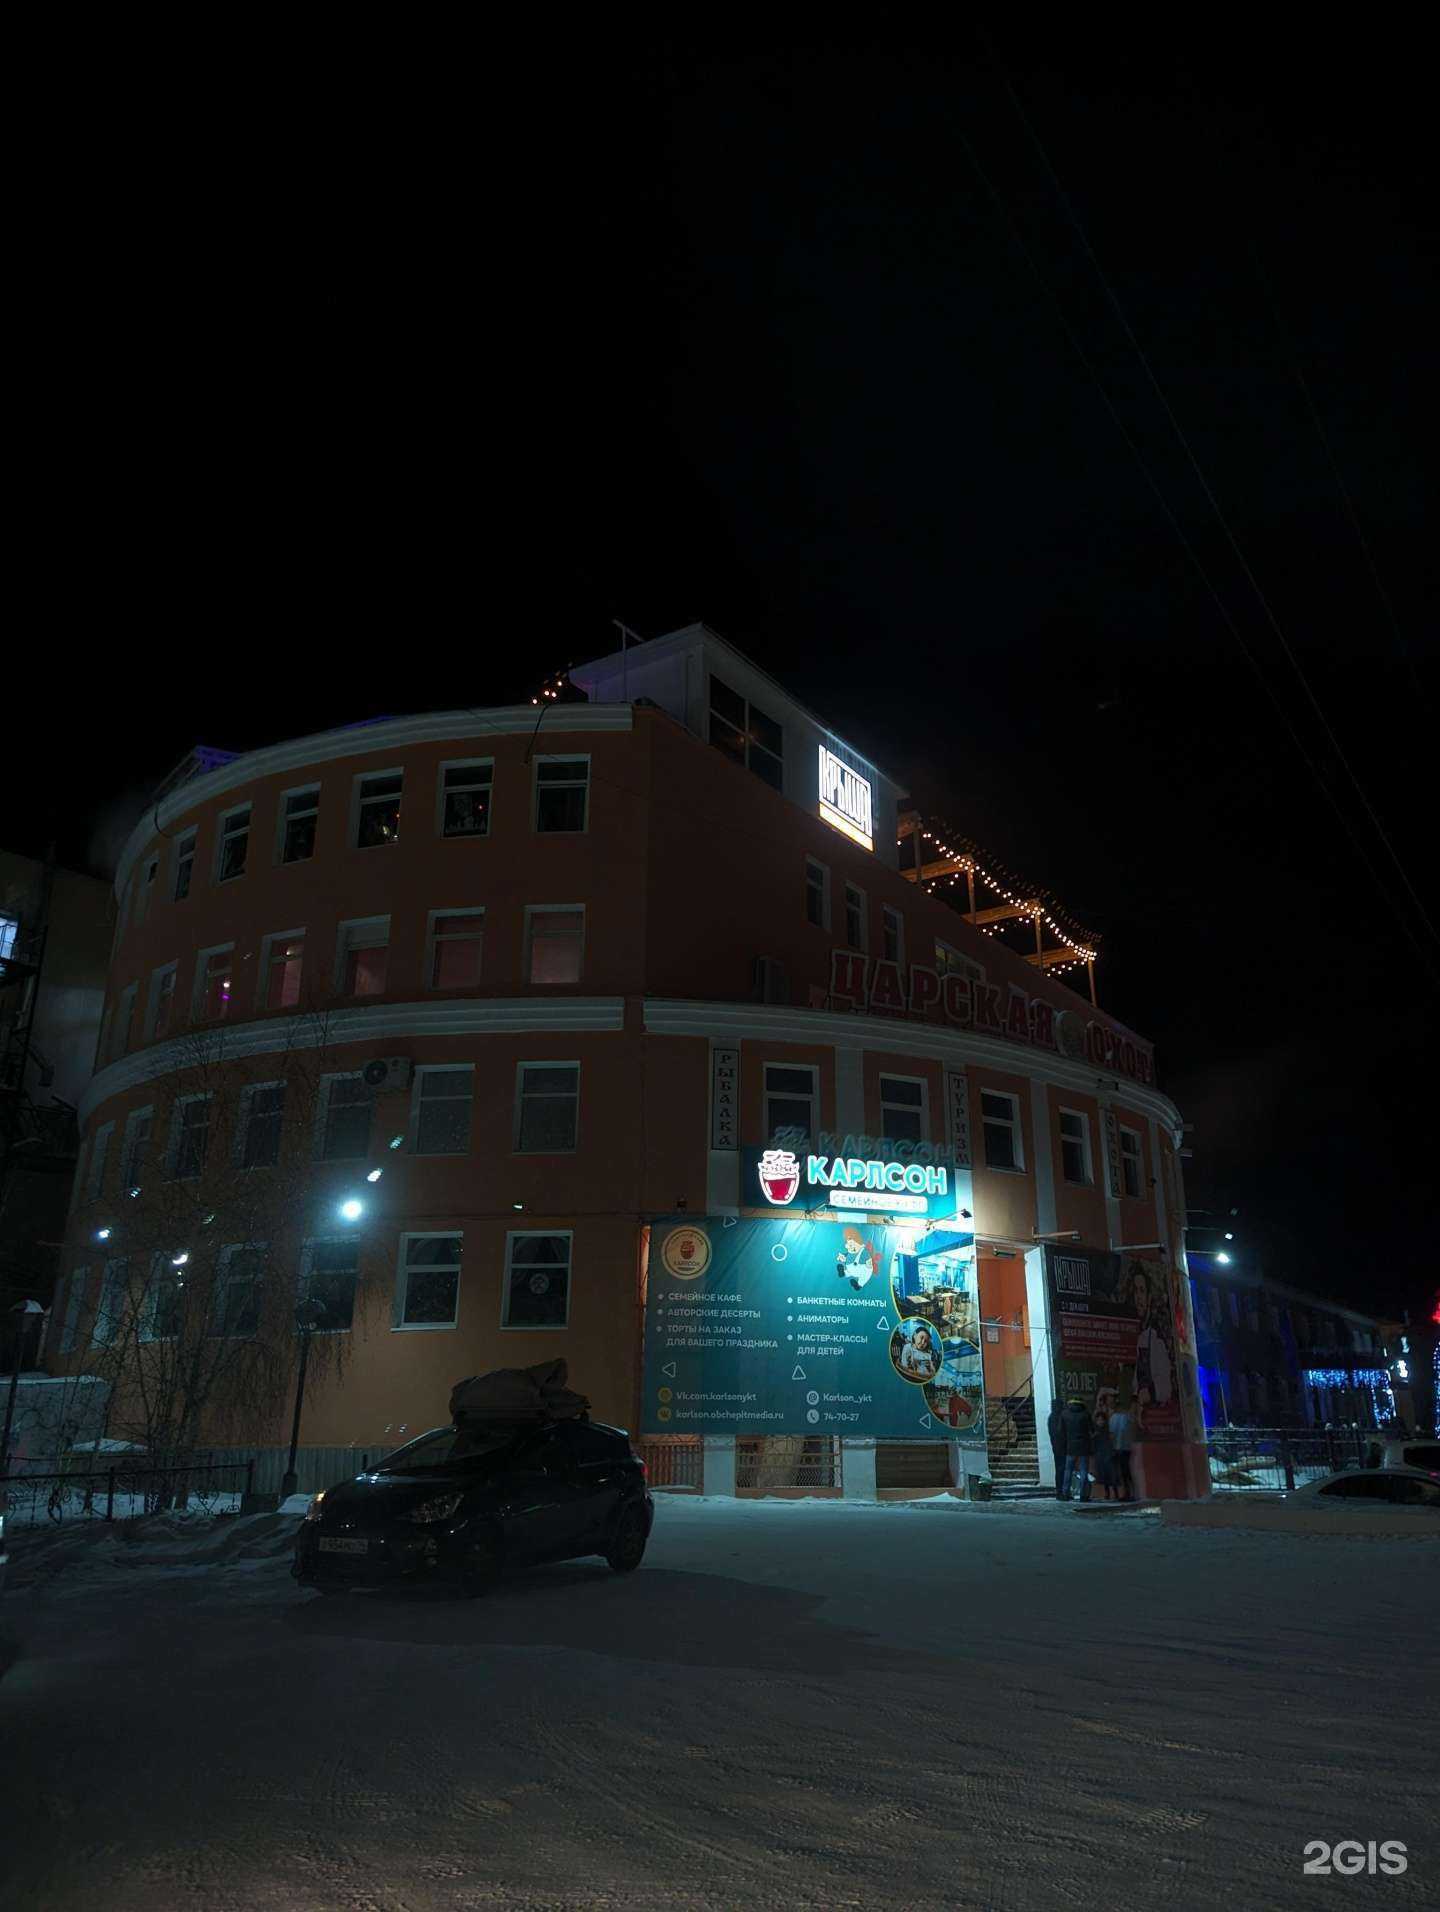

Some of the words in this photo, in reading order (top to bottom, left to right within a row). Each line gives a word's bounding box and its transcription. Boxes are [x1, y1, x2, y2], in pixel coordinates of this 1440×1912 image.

[819, 744, 872, 839] КРЫША
[828, 948, 1056, 1050] ЦАРСКАЯ
[717, 1054, 735, 1146] РЫБАЛКА
[952, 1077, 970, 1165] ТУРИЗМ
[807, 1154, 948, 1196] КАРЛСОН
[668, 1291, 716, 1302] СЕМЕЙНОЕ
[718, 1294, 743, 1302] КАФЕ
[797, 1296, 846, 1306] БАНКЕТНЫЕ
[847, 1299, 887, 1308] КОМНАТЫ
[667, 1308, 720, 1317] АВТОРСКИЕ
[720, 1309, 761, 1319] ДЕСЕРТЫ
[797, 1314, 849, 1324] АНИМАТОРЫ
[667, 1325, 696, 1333] ТОРТЫ
[698, 1325, 711, 1334] НА
[713, 1326, 742, 1335] ЗАКАЗ
[666, 1338, 685, 1346] ДЛЯ
[687, 1338, 725, 1347] ВАШЕГО
[726, 1339, 778, 1349] ПРАЗДНИКА
[797, 1334, 868, 1343] МАСТЕР-КЛАССЫ
[797, 1346, 816, 1356] ДЛЯ
[817, 1346, 844, 1356] ДЕТЕЙ
[823, 1412, 860, 1421] 74-70-27
